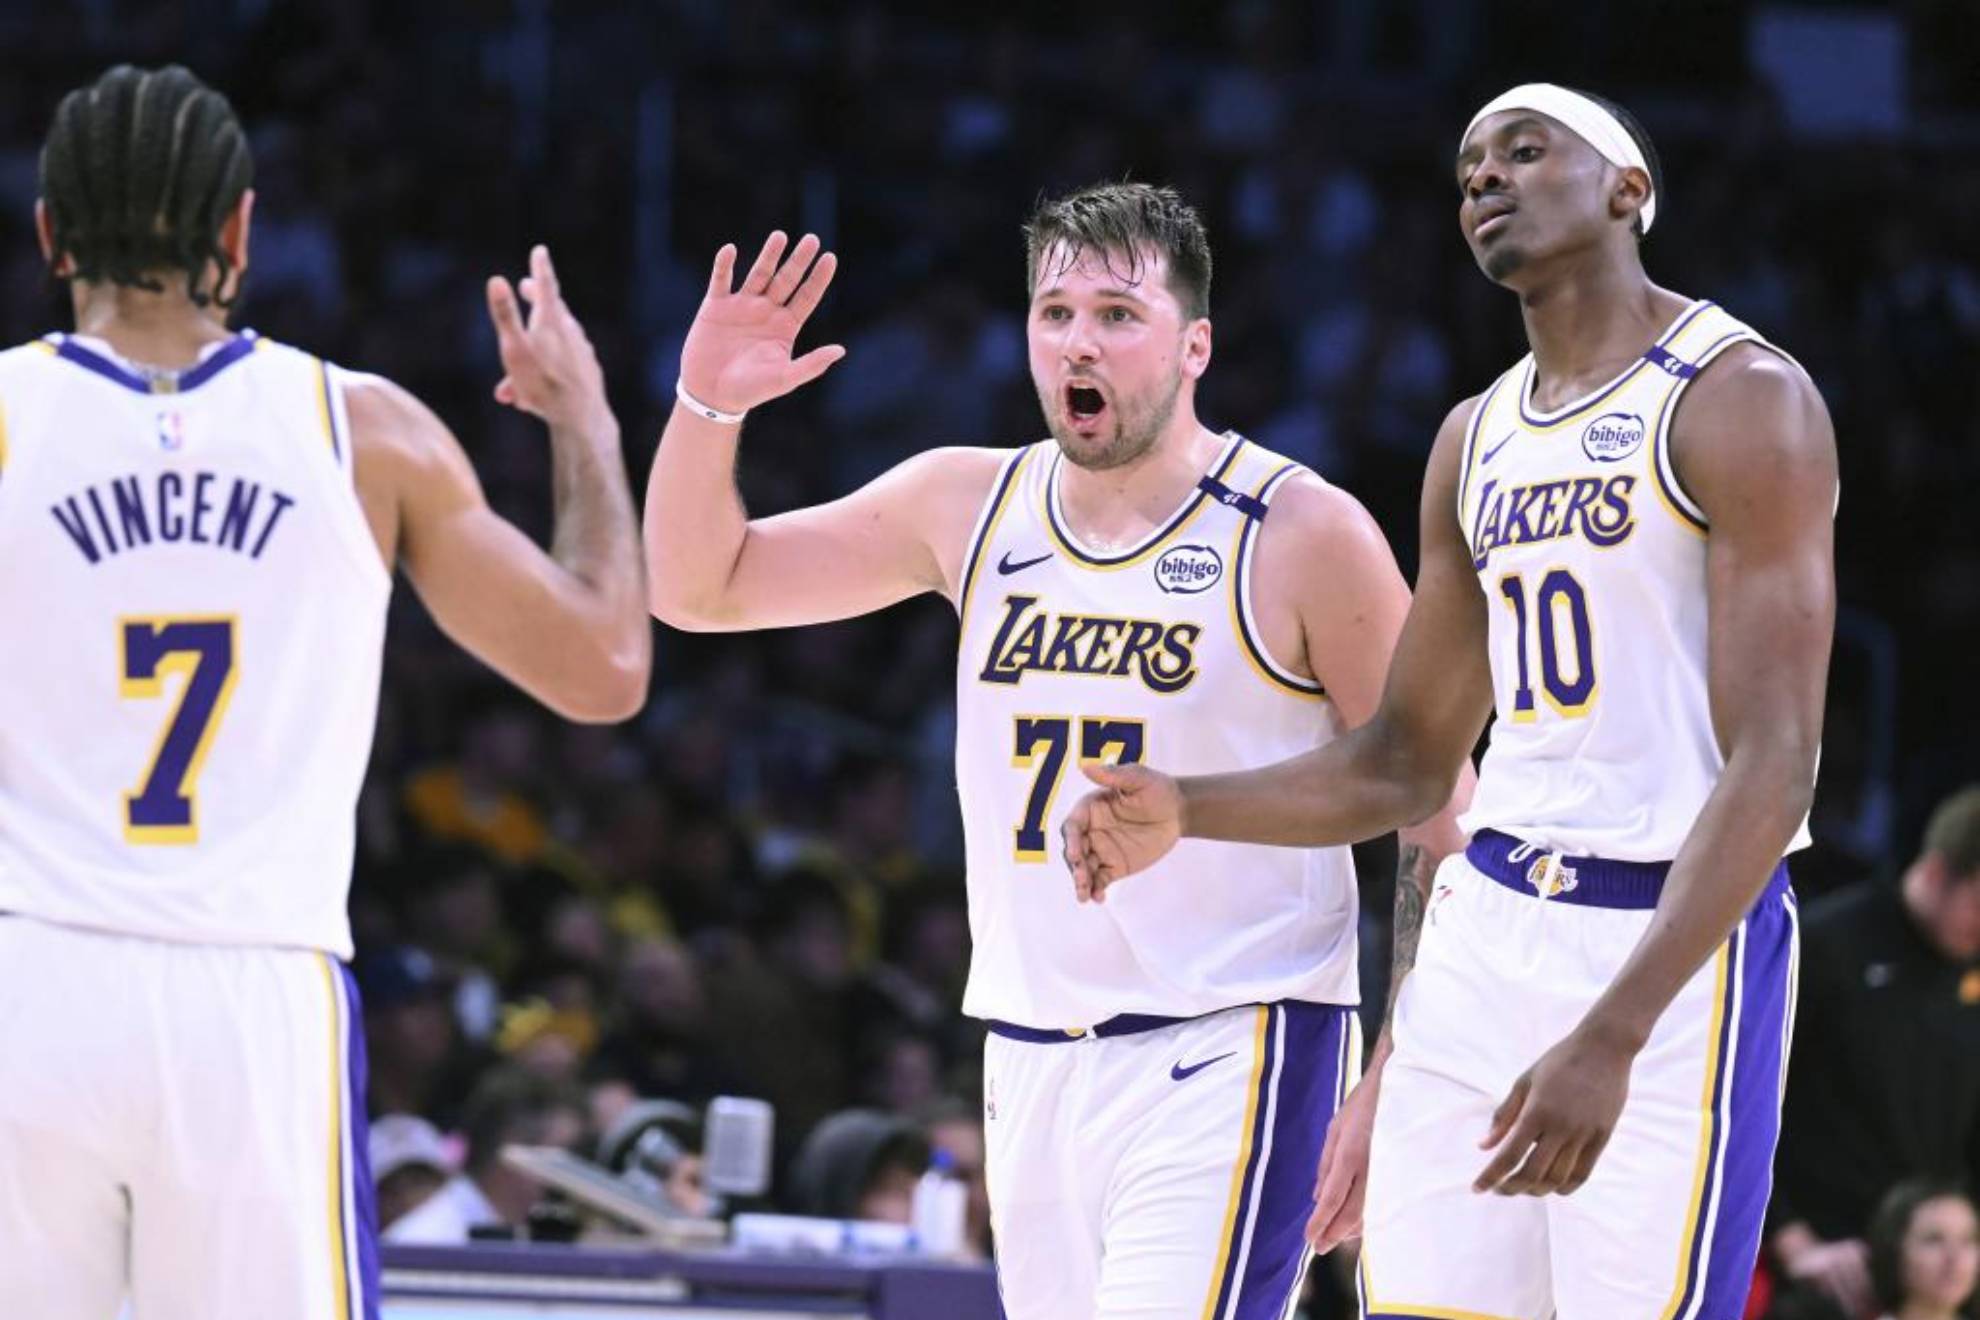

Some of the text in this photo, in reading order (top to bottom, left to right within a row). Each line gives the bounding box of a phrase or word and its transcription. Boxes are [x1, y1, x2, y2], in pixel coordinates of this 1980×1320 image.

[1588, 424, 1641, 448] bibigo
[51, 472, 295, 564] VINCENT
[1473, 474, 1637, 572] LAKERS
[1161, 557, 1219, 581] bibigo
[977, 594, 1204, 695] LAKERS
[1498, 566, 1600, 724] 10
[116, 613, 241, 847] 7
